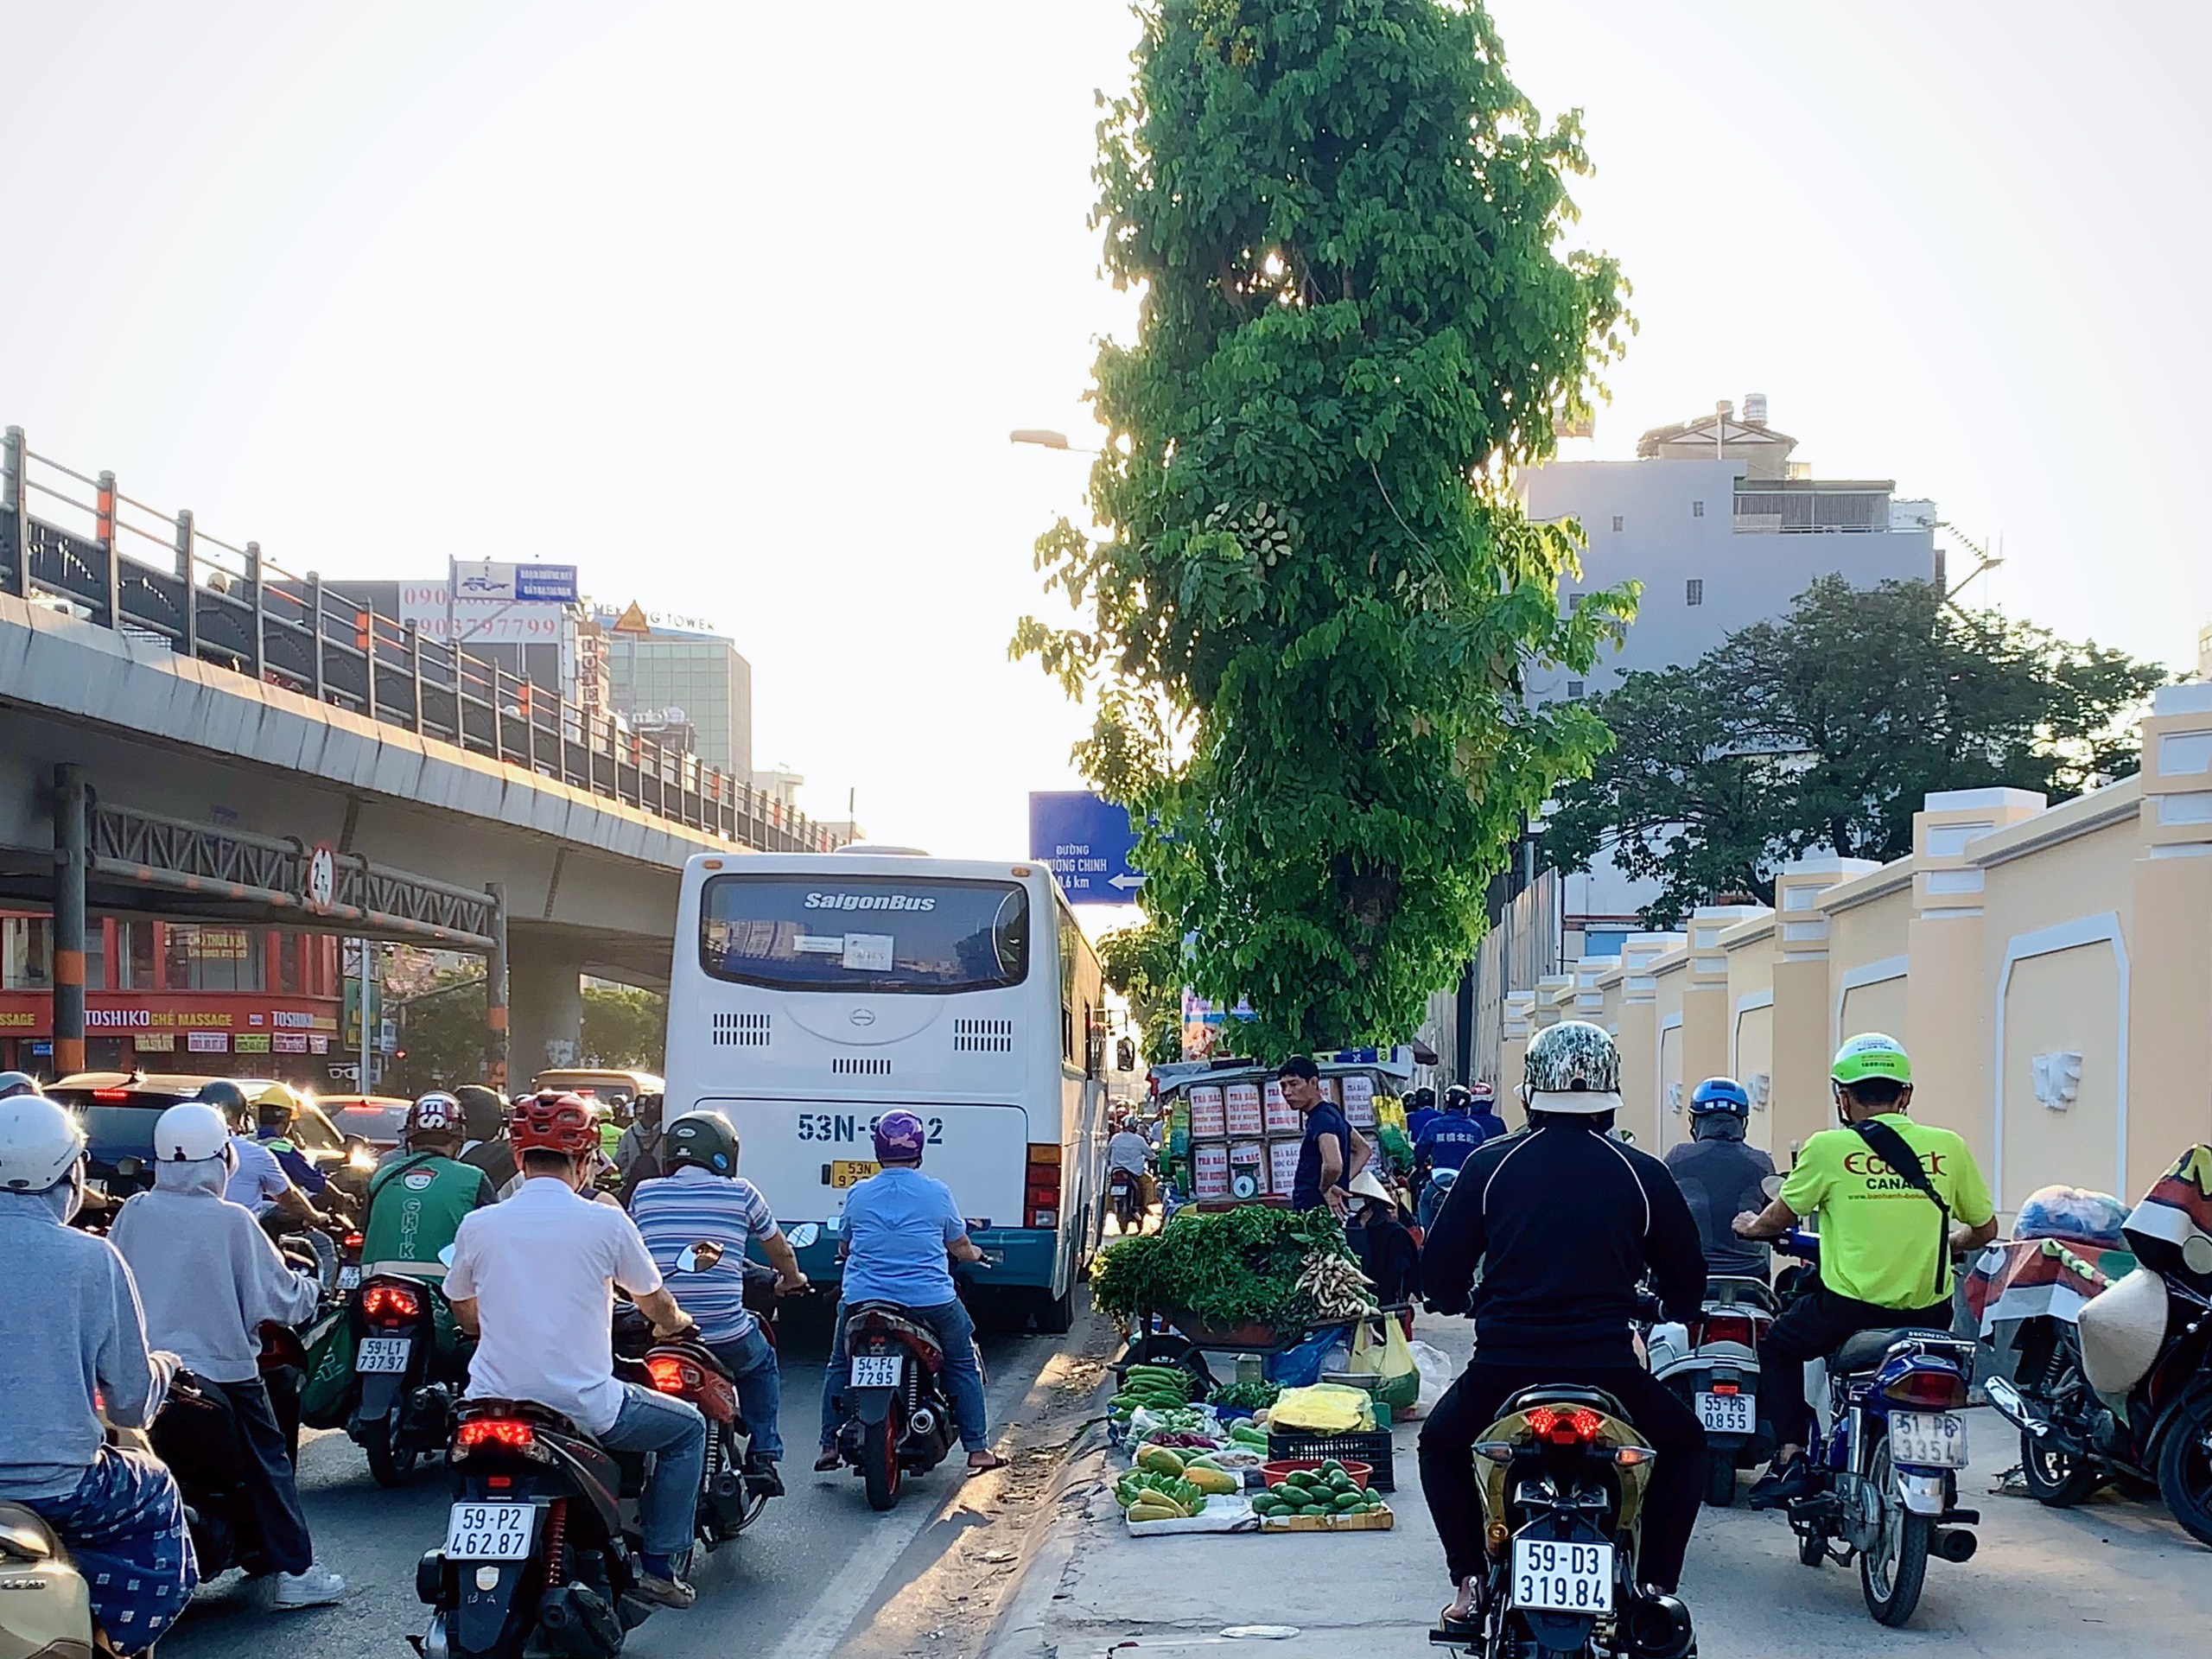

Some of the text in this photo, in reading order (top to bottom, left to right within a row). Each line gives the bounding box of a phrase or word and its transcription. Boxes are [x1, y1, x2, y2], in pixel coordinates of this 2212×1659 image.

[1056, 842, 1090, 855] ĐƯỜNG
[1077, 859, 1107, 872] CHINH
[1073, 874, 1090, 888] km
[804, 893, 936, 911] SaigonBus
[84, 1009, 150, 1027] TOSHIKO
[178, 1013, 233, 1027] MASSAGE
[848, 1163, 872, 1175] 53N
[398, 1198, 422, 1260] GHTK
[366, 1340, 402, 1356] 59-L1
[858, 1357, 893, 1371] 54-F4
[857, 1371, 893, 1385] 7295
[1705, 1395, 1746, 1414] 55-P6
[1705, 1413, 1747, 1430] 0855
[462, 1508, 522, 1530] 59-P2
[451, 1533, 525, 1555] 462.87
[1528, 1542, 1599, 1575] 59-D3
[1520, 1574, 1605, 1609] 319.84
